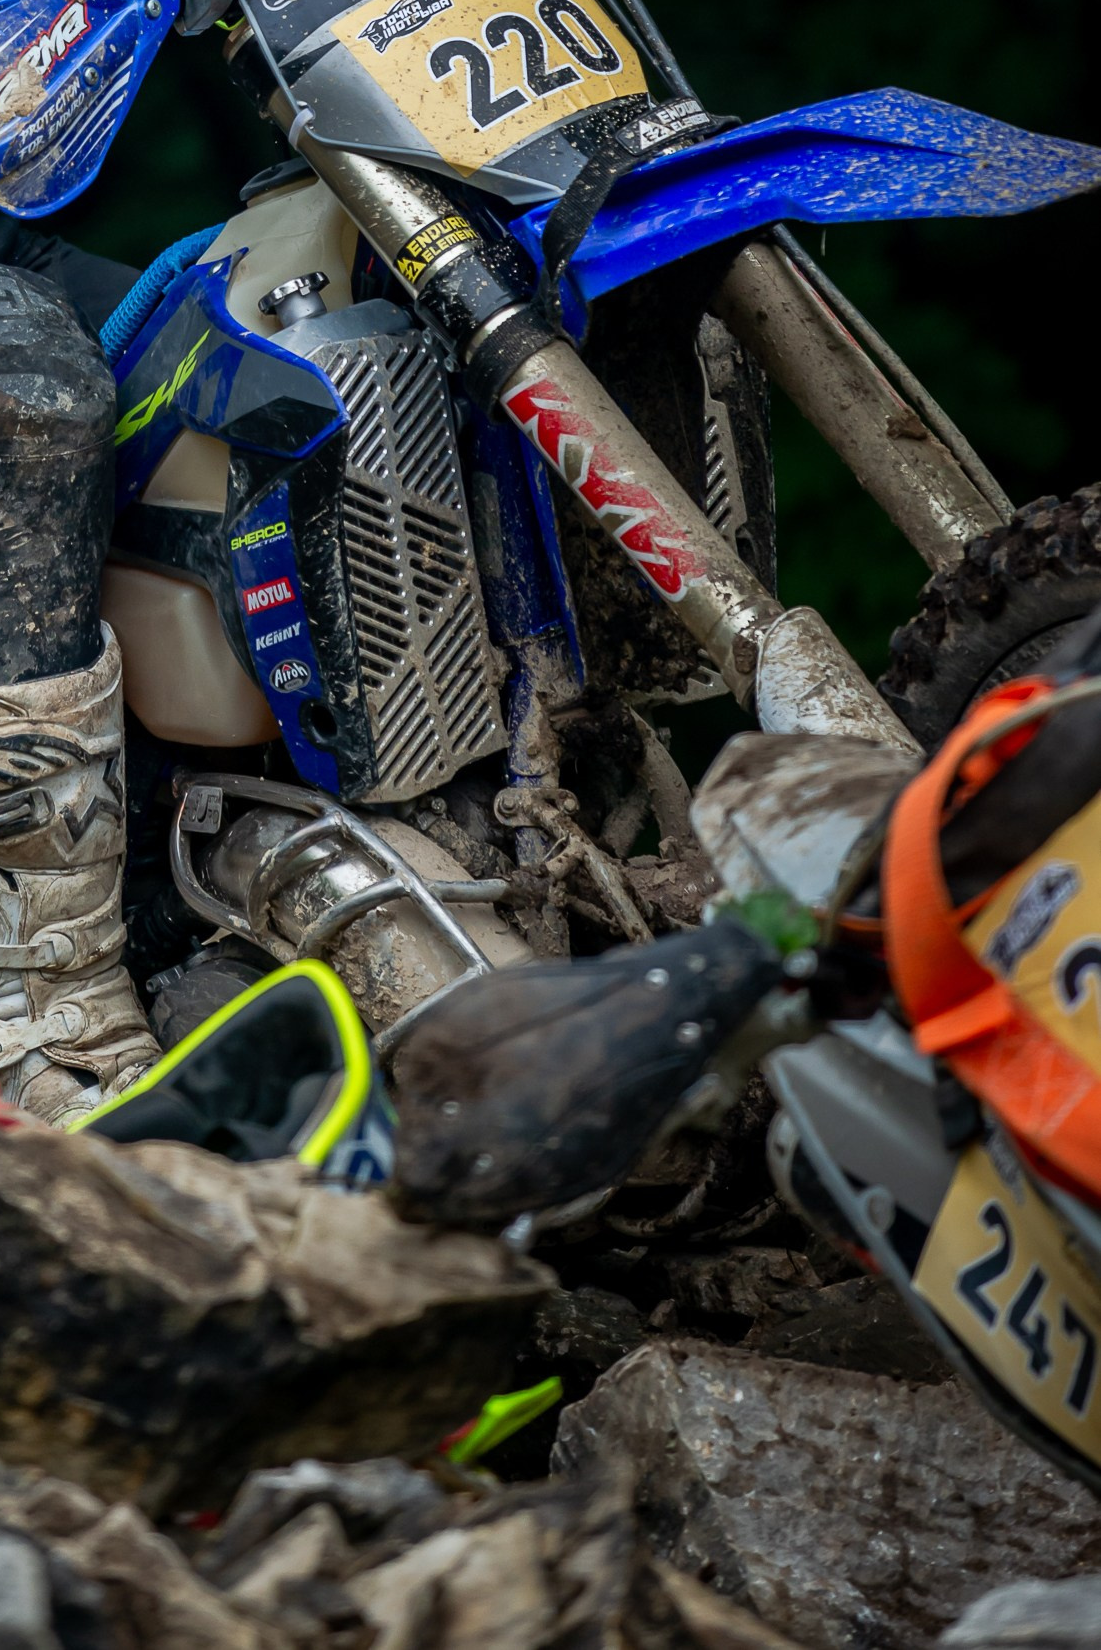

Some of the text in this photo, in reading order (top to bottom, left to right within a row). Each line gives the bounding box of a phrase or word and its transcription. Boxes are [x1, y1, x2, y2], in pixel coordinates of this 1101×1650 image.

[378, 1, 423, 30] ТОЧКА
[19, 75, 81, 145] PROTECTION
[656, 100, 703, 125] ENDUR
[18, 91, 86, 162] FOR ENDURO
[406, 216, 471, 258] ENDURO
[230, 521, 287, 551] SHERCO
[247, 581, 292, 612] MOTUL
[255, 621, 301, 652] KENNY
[274, 662, 309, 688] Airoh
[957, 1201, 1098, 1416] 247
